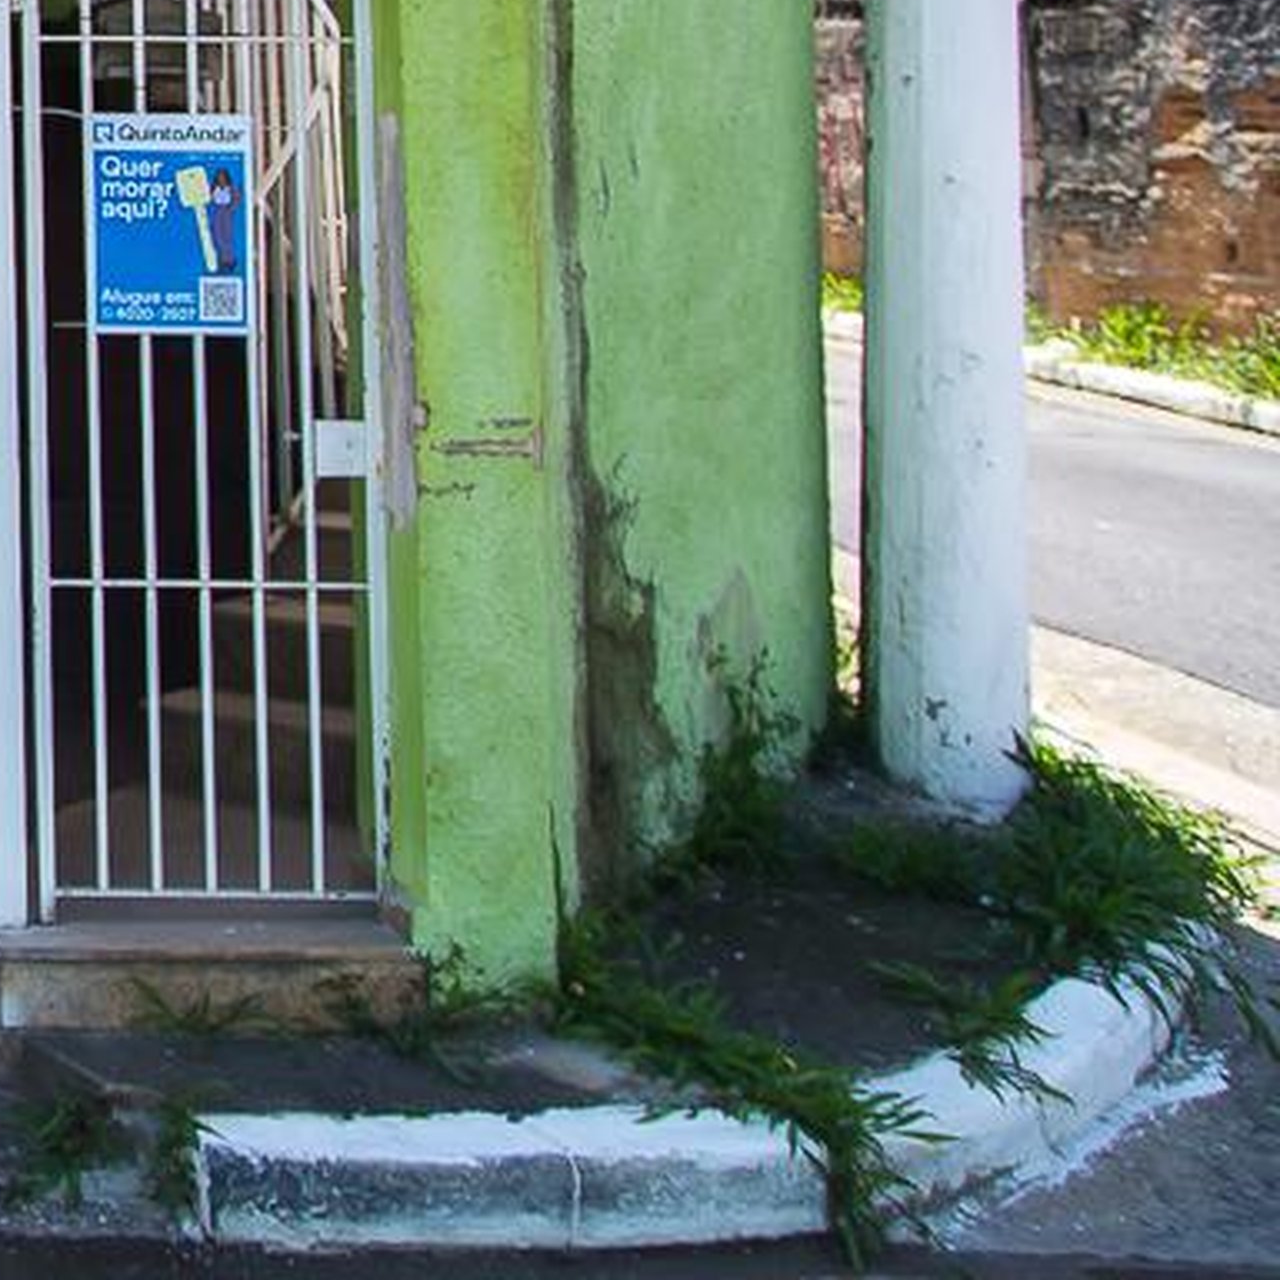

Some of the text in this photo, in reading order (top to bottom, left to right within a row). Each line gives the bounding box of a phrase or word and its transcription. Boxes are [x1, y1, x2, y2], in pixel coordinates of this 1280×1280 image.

[117, 123, 246, 142] QuintoAndar
[100, 155, 164, 178] Quer
[100, 180, 175, 198] morar
[100, 198, 169, 223] aqui?
